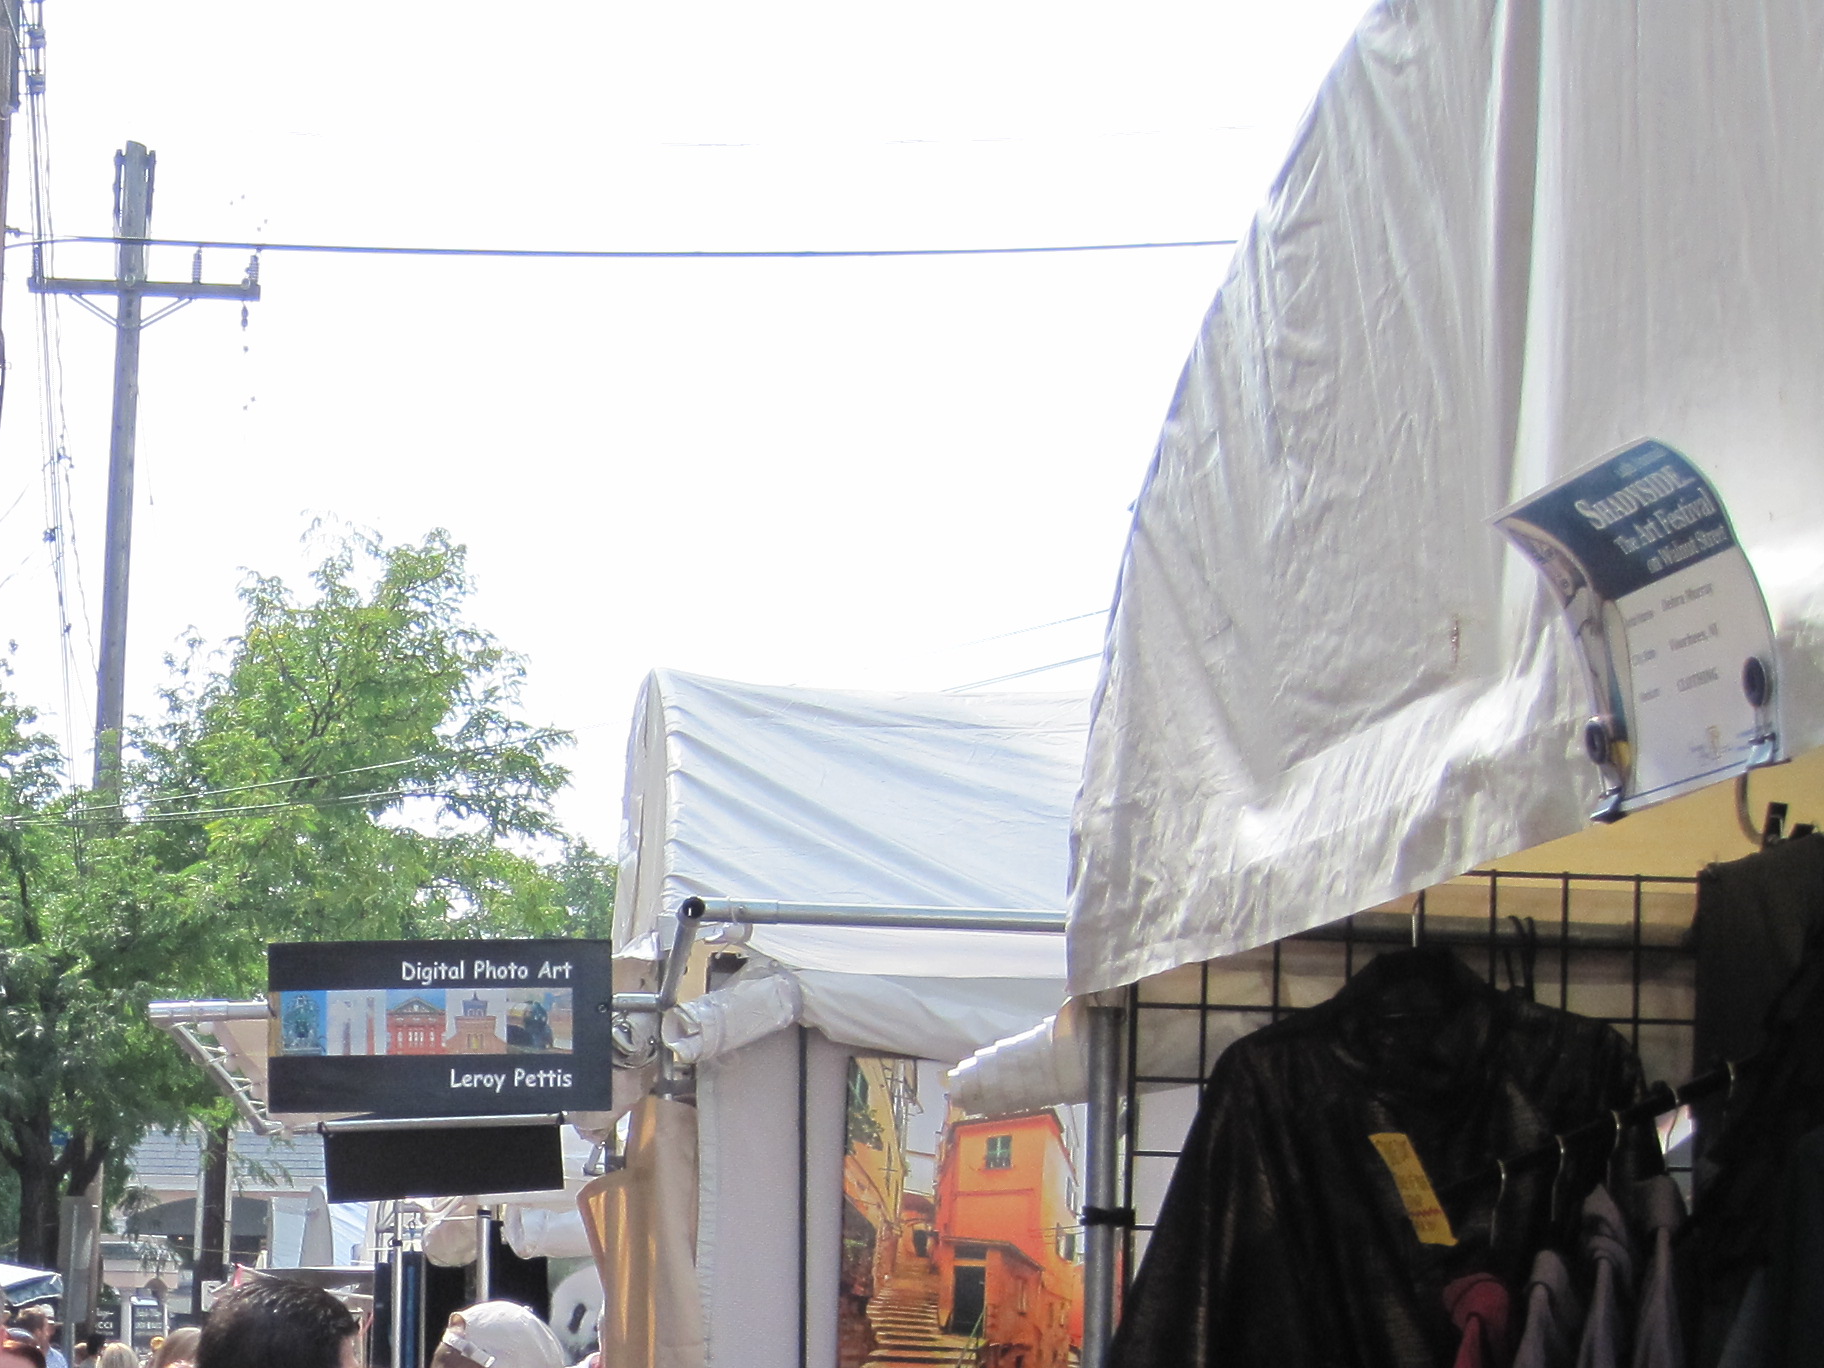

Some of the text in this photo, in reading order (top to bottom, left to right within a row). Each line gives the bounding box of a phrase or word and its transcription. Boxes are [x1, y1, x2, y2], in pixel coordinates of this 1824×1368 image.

[402, 960, 572, 984] Digital Photo Art
[450, 1068, 572, 1093] Leroy Pettis
